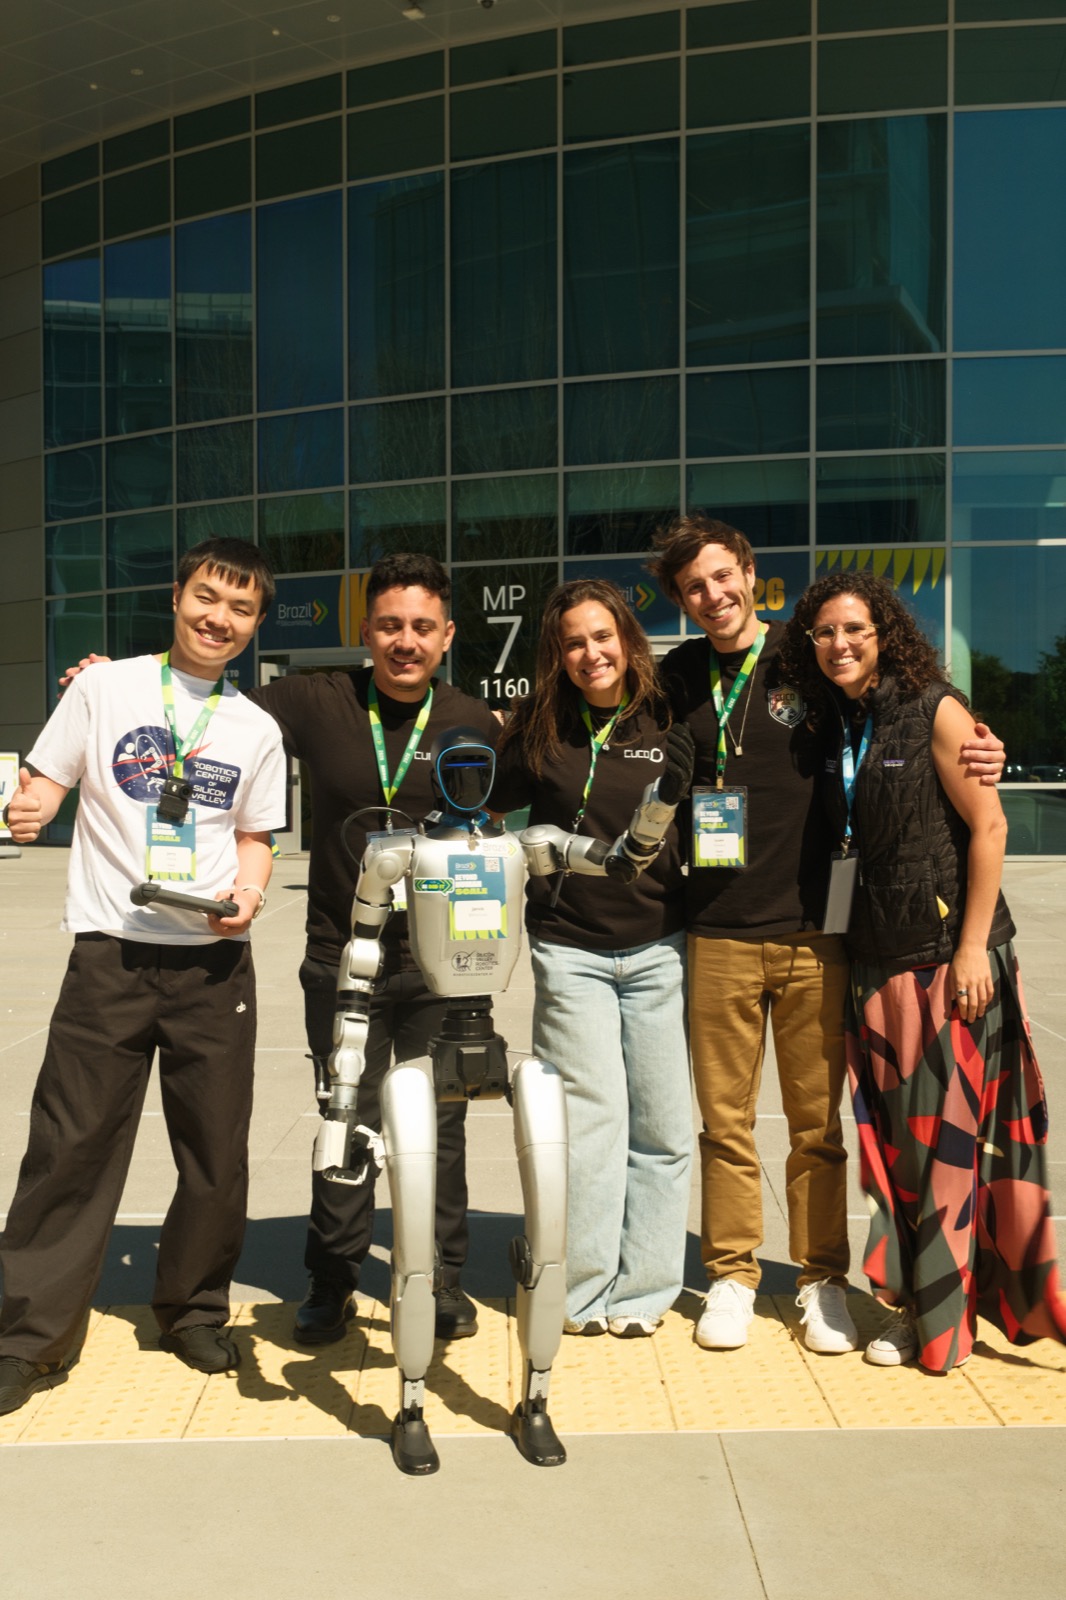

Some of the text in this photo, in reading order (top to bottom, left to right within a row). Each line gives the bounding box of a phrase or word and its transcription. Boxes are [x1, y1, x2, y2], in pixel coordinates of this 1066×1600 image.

[483, 585, 526, 611] MP
[278, 602, 312, 619] Brazil
[487, 615, 523, 674] 7
[480, 678, 530, 698] 1160
[193, 761, 238, 778] ROBOTICS
[195, 770, 232, 783] CENTER
[191, 793, 226, 804] VALLEY
[193, 784, 227, 797] SILICON
